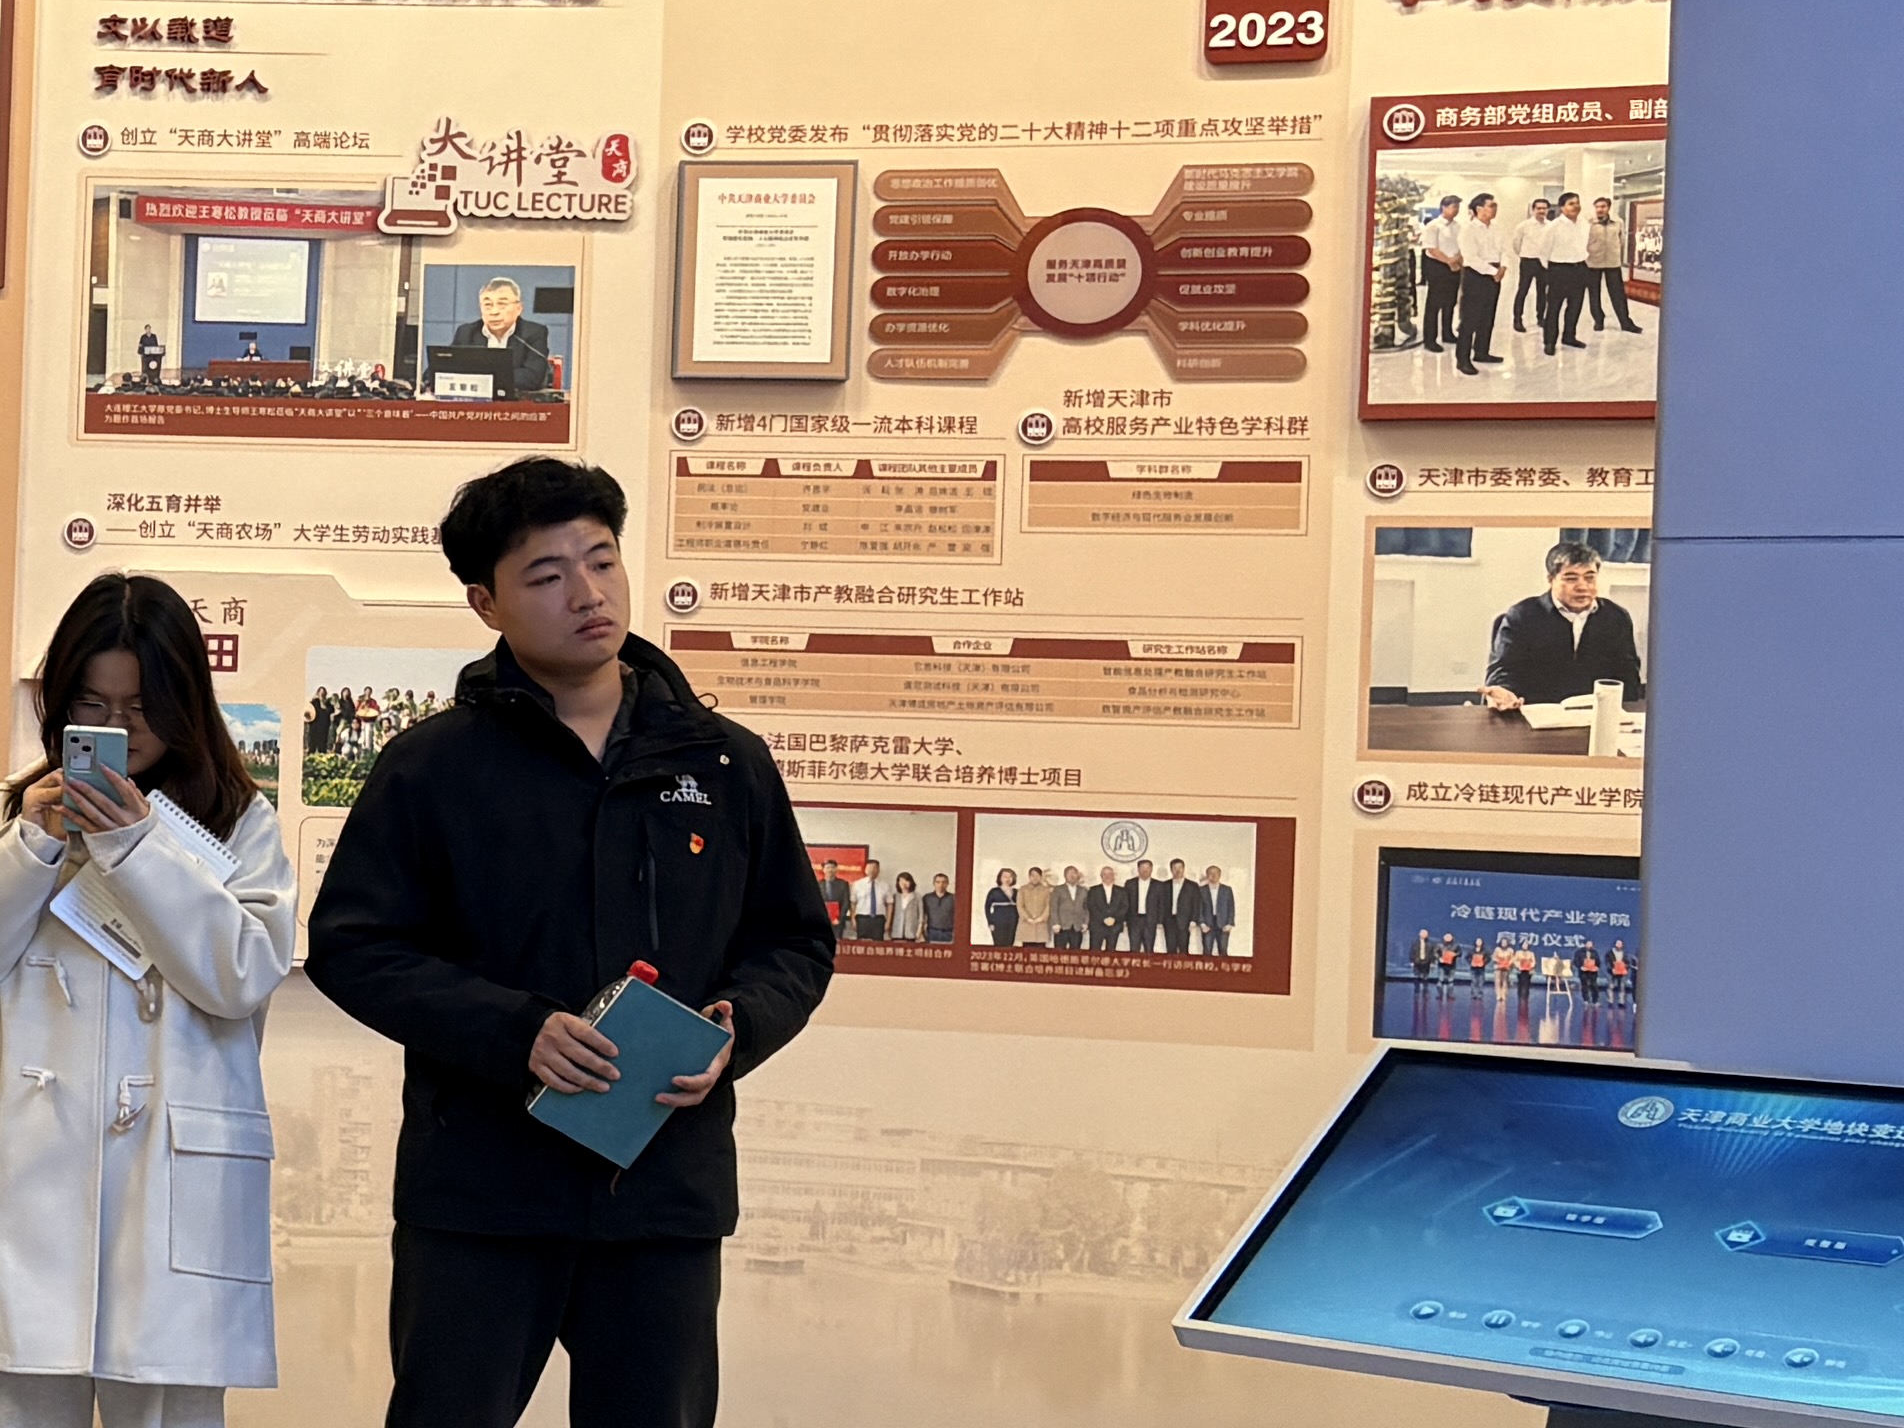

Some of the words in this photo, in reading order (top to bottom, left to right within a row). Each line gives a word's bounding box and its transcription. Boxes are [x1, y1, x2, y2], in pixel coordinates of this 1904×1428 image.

[96, 16, 234, 44] 文以载道
[1209, 11, 1325, 49] 2023
[94, 64, 268, 94] 育时代新人
[120, 128, 158, 146] 创立
[170, 127, 281, 150] “天商大讲堂”
[293, 131, 370, 150] 高端论坛
[726, 123, 849, 144] 学校党委发布
[862, 115, 1323, 144] “贯彻落实党的二十大精神十二项重点攻坚举措”
[428, 117, 587, 188] 大讲堂
[460, 190, 508, 212] TUC
[517, 191, 627, 214] LECTURE
[294, 206, 373, 226] “天商大讲堂”
[888, 250, 952, 261] 开放办学行动
[1046, 259, 1126, 269] 服务天津高质量
[886, 286, 939, 297] 数字化治理
[1063, 389, 1172, 409] 新增天津市
[716, 414, 977, 435] 新增4门国家级一流本科课程
[1063, 415, 1308, 436] 高校服务产业特色学科群
[706, 461, 746, 471] 课程名称
[792, 462, 843, 472] 课程负责人
[1418, 467, 1654, 487] 天津市委常委、教育工
[107, 493, 222, 514] 深化五育并举
[187, 521, 282, 541] “天商农场”
[710, 583, 1024, 607] 新增天津市产教融合研究生工作站
[190, 598, 247, 626] 天商
[953, 640, 992, 651] 合作企业
[1143, 644, 1227, 655] 研究生工作站名称
[660, 791, 712, 805] CAMEL
[1406, 782, 1643, 808] 成立冷链现代产业学院
[1451, 904, 1630, 927] 冷链现代产业学院
